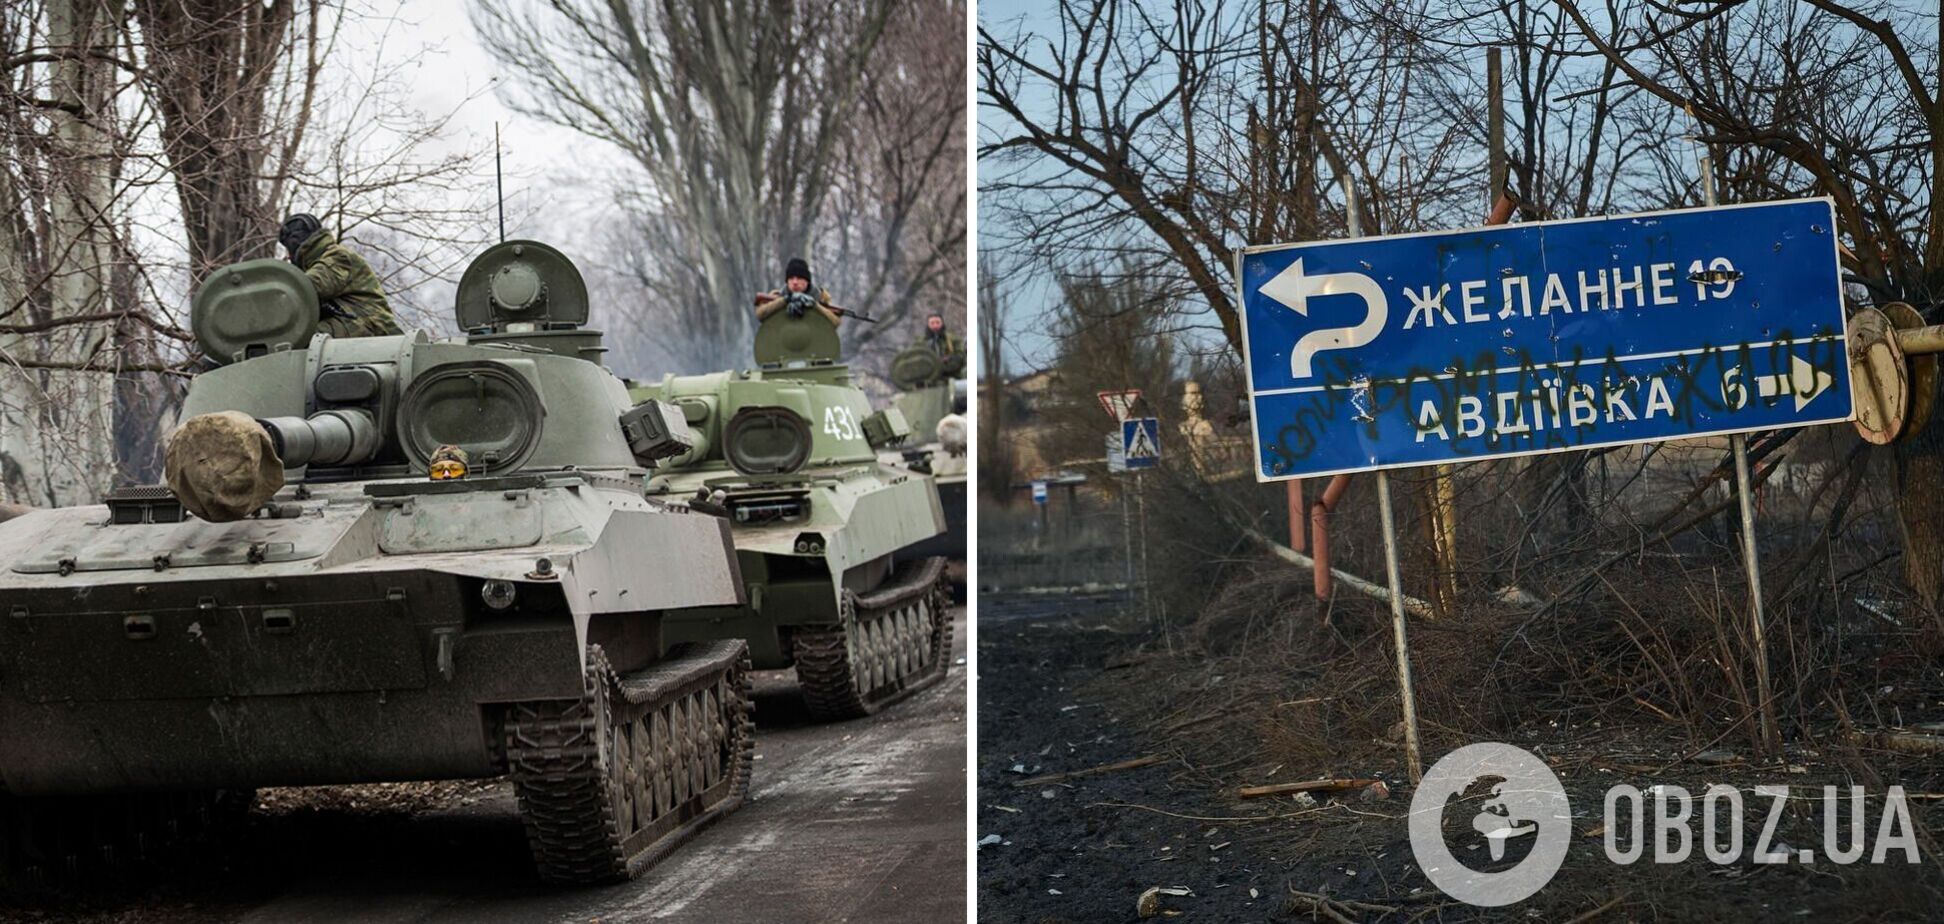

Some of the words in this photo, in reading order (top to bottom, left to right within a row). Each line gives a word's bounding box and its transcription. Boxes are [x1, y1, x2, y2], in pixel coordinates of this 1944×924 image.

[1402, 262, 1679, 330] ЖЕЛАННЕ
[1688, 257, 1736, 301] 19
[824, 405, 863, 441] 431
[1415, 377, 1675, 443] АВДІЇВКА
[1721, 365, 1748, 410] 6
